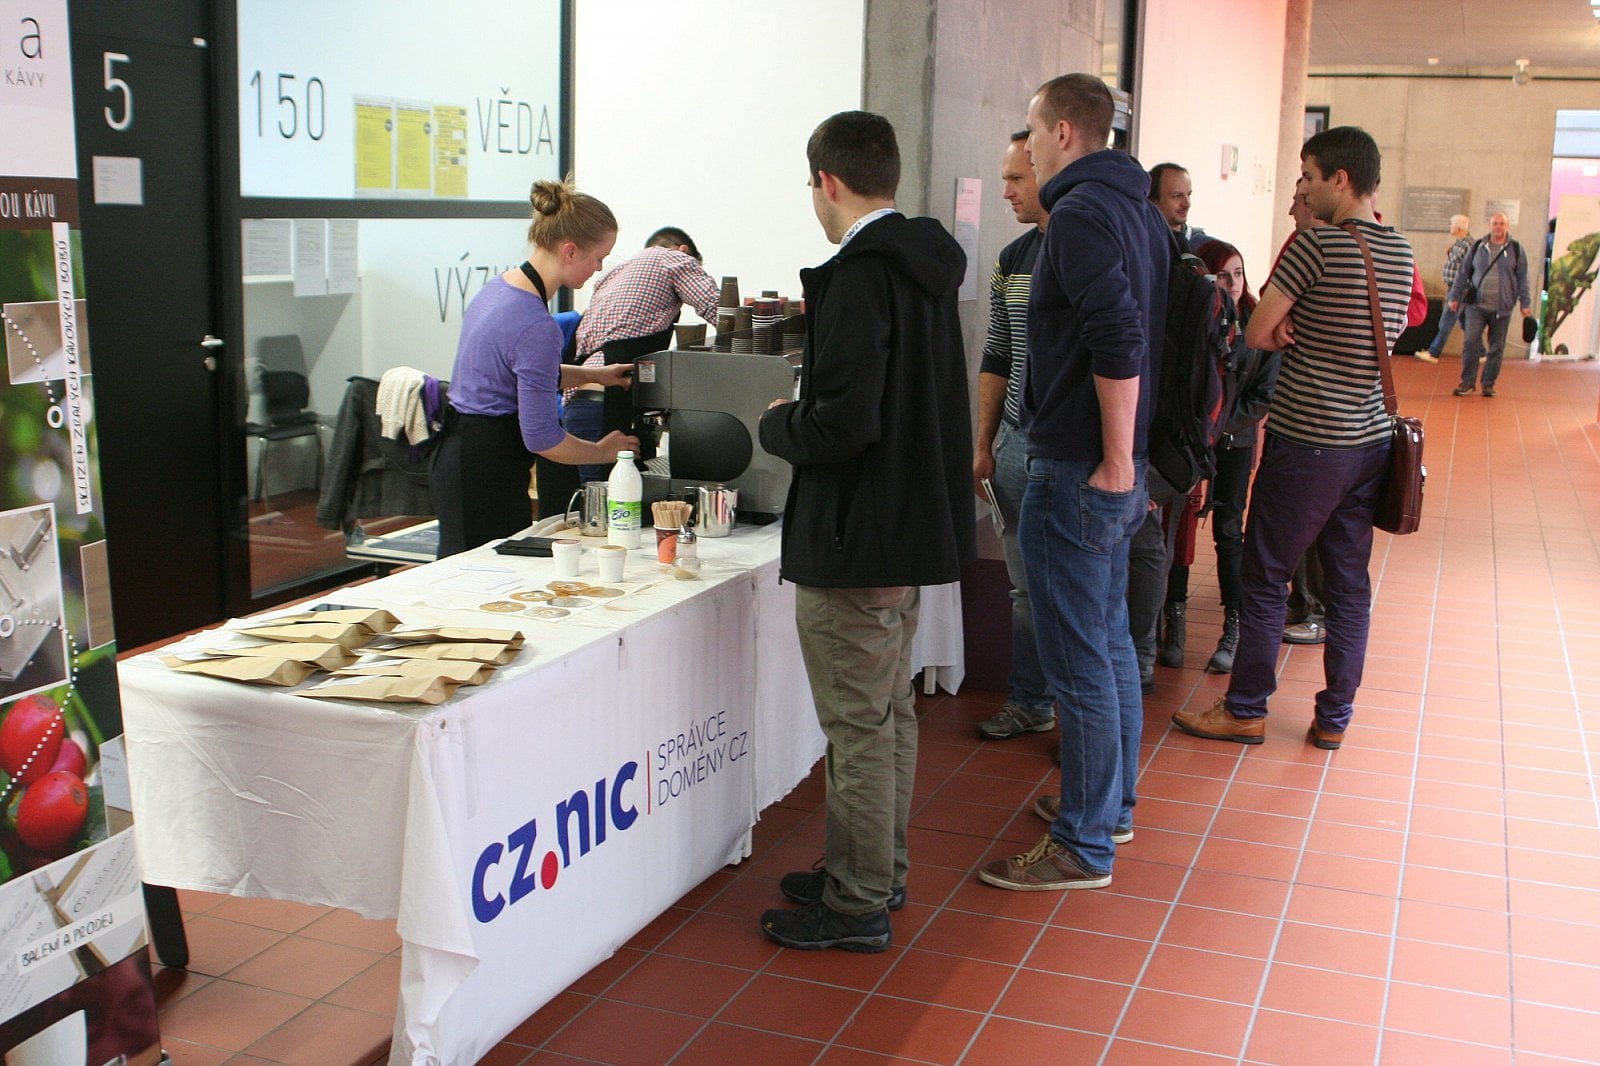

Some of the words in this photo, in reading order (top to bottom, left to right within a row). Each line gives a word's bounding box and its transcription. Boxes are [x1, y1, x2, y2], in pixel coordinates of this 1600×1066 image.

[20, 17, 43, 60] a
[5, 67, 45, 88] KÁVY
[103, 51, 132, 131] 5
[250, 69, 326, 141] 150
[476, 87, 554, 156] VĚDA
[24, 189, 56, 218] KÁVU
[67, 371, 84, 438] ZRALÝCH
[658, 710, 726, 771] SPRÁVCE
[658, 745, 726, 806] DOMÉNY
[729, 731, 748, 762] CZ
[21, 932, 60, 967] BALENÍ
[63, 933, 71, 946] A
[73, 912, 113, 942] PRODEJ
